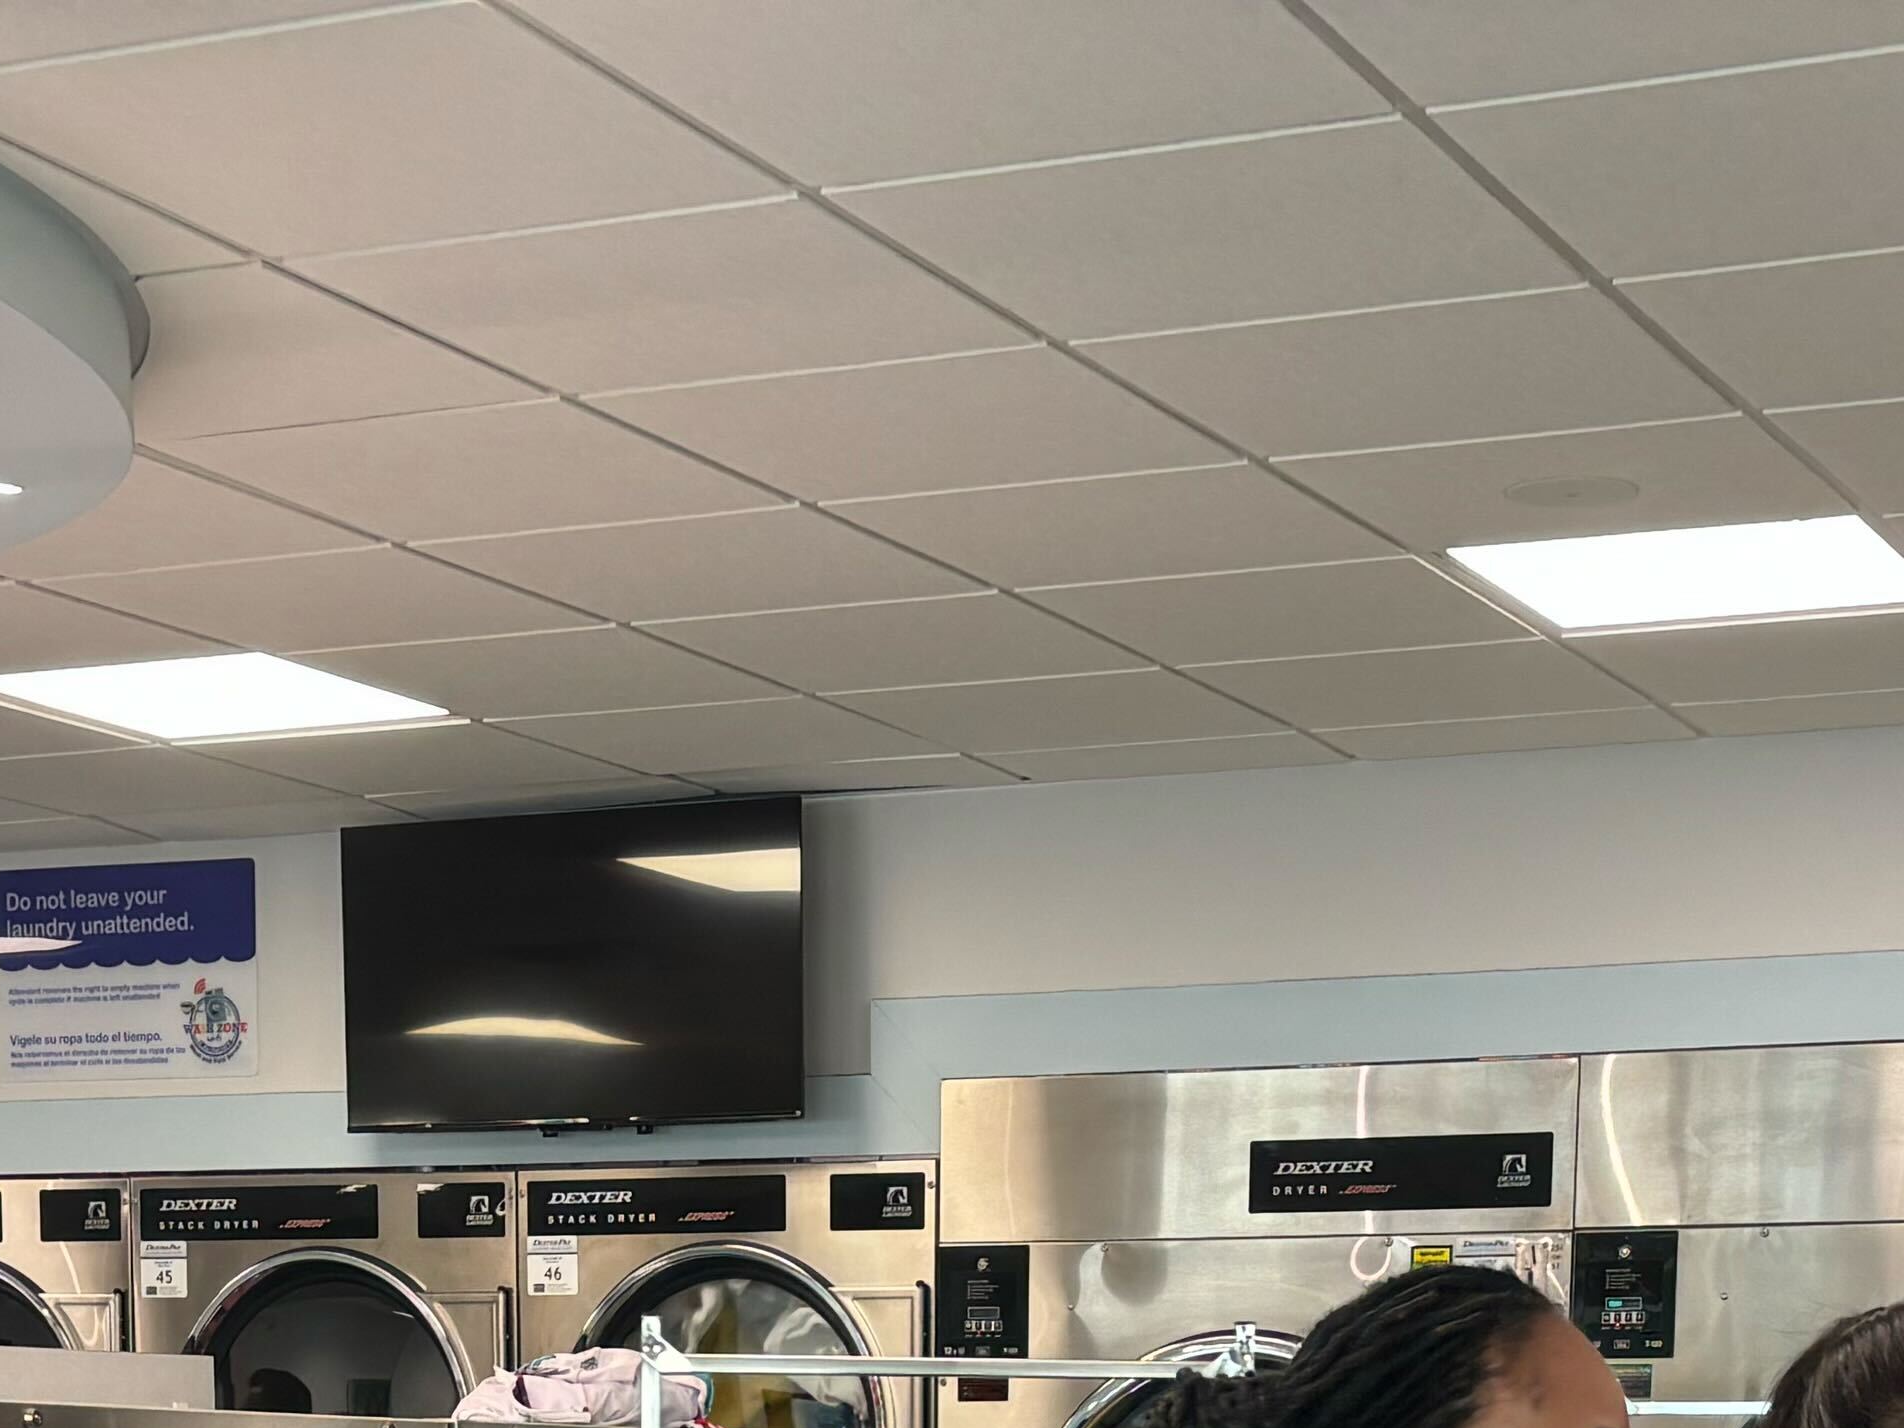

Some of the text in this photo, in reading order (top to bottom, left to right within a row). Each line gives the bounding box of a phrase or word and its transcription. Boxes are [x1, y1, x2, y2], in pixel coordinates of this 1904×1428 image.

[6, 889, 167, 911] Do not leave your
[7, 912, 194, 939] laundry unattended.
[44, 1036, 56, 1045] su
[59, 1035, 83, 1046] ropa
[1273, 1160, 1374, 1175] DEXTER
[548, 1190, 633, 1205] DEXTER
[1272, 1185, 1328, 1196] DRYER
[159, 1199, 237, 1212] DEXTER
[159, 1219, 259, 1230] STACK DRYER
[548, 1213, 657, 1225] STACK DRYER
[155, 1270, 173, 1285] 45
[543, 1266, 562, 1281] 46
